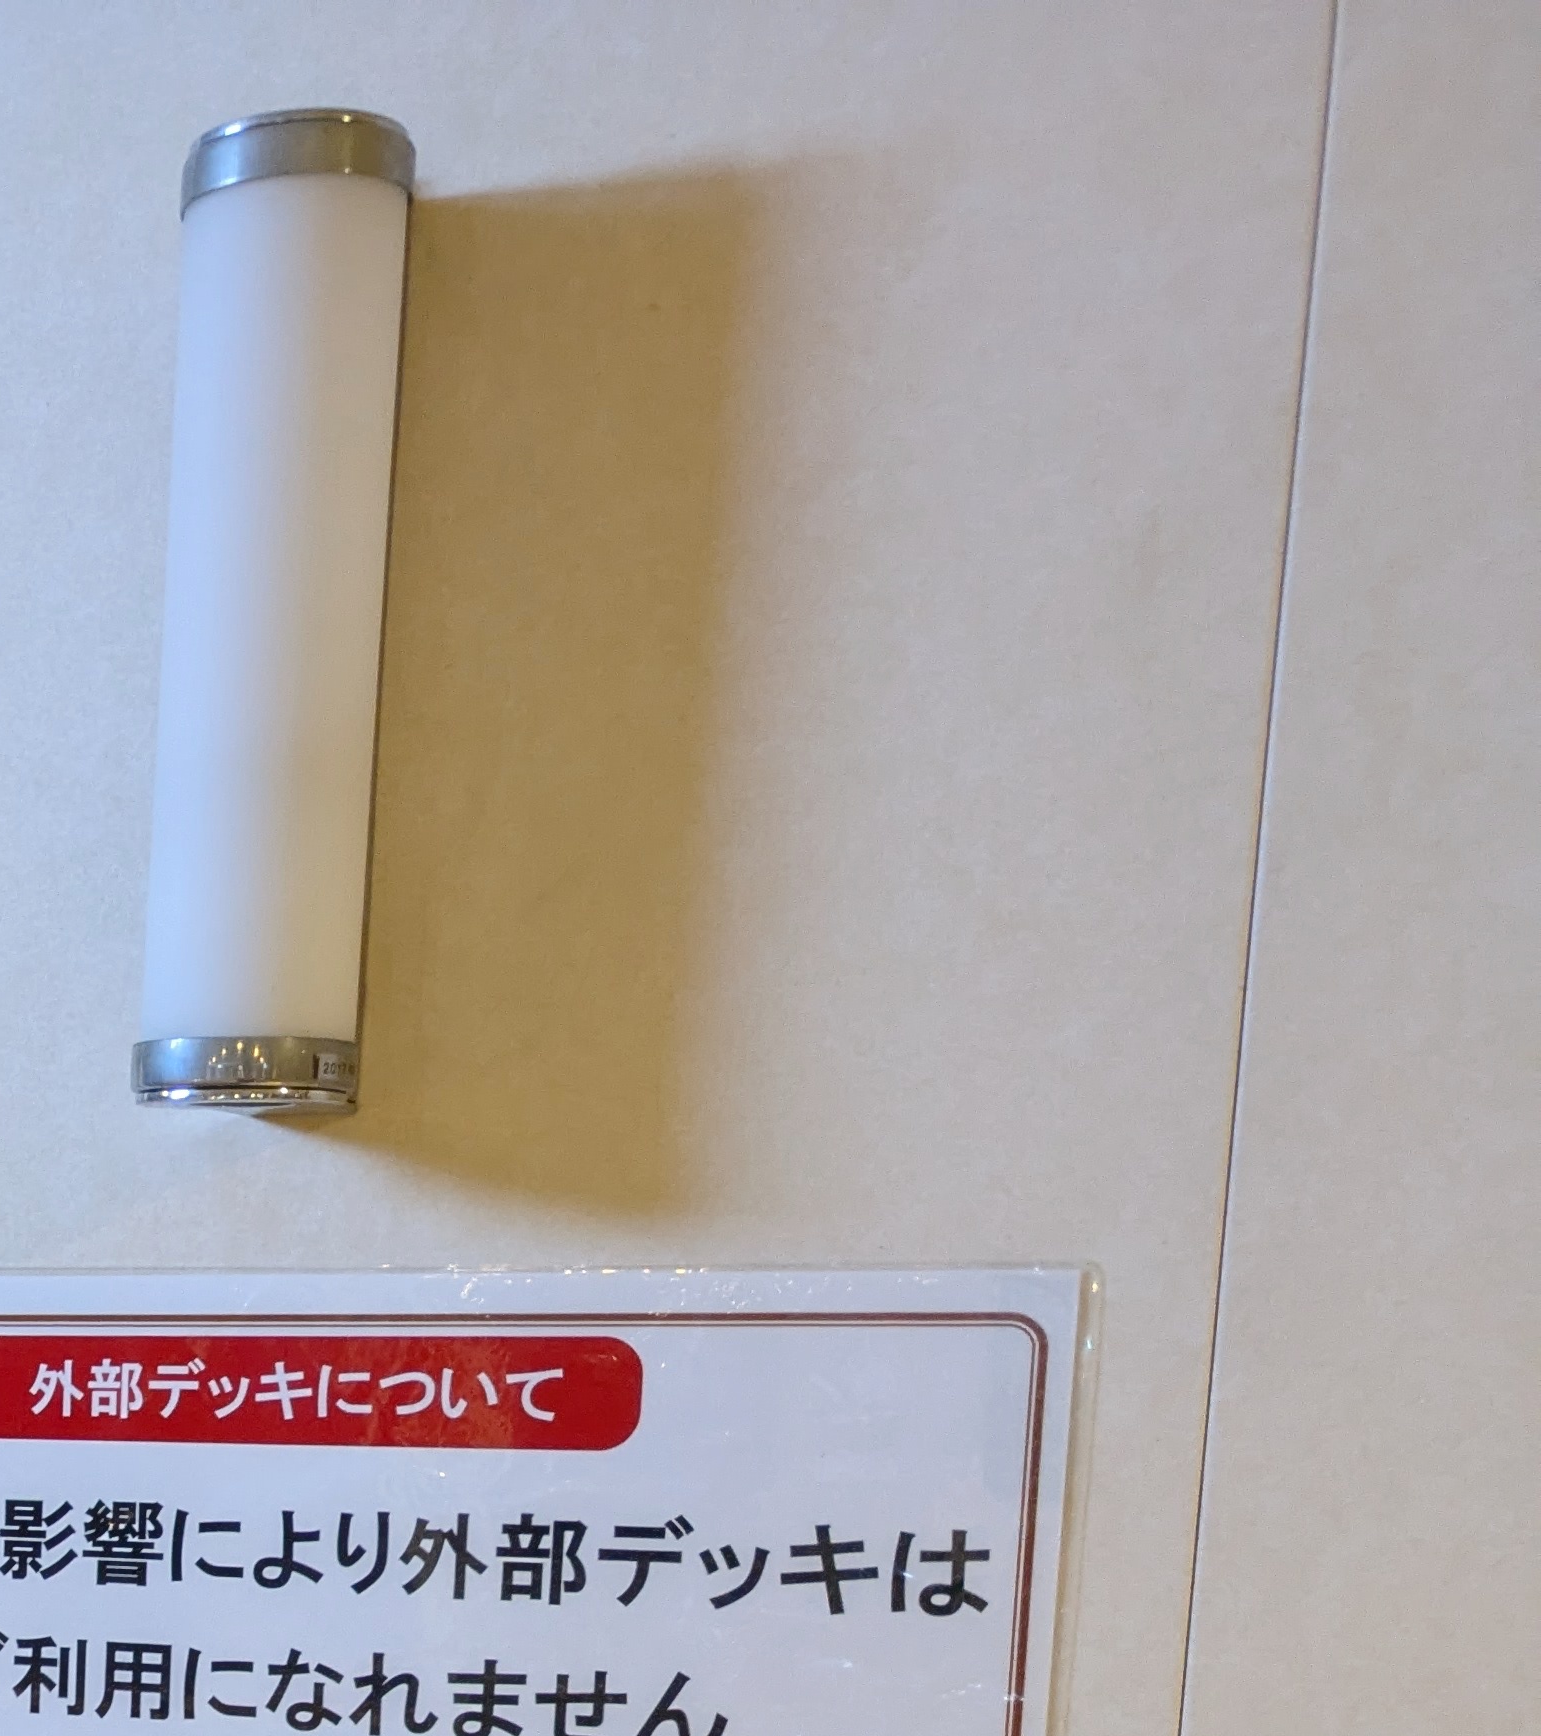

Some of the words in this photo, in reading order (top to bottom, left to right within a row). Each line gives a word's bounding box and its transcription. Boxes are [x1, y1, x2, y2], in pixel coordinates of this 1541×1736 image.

[27, 1358, 565, 1425] 外部デッキについて
